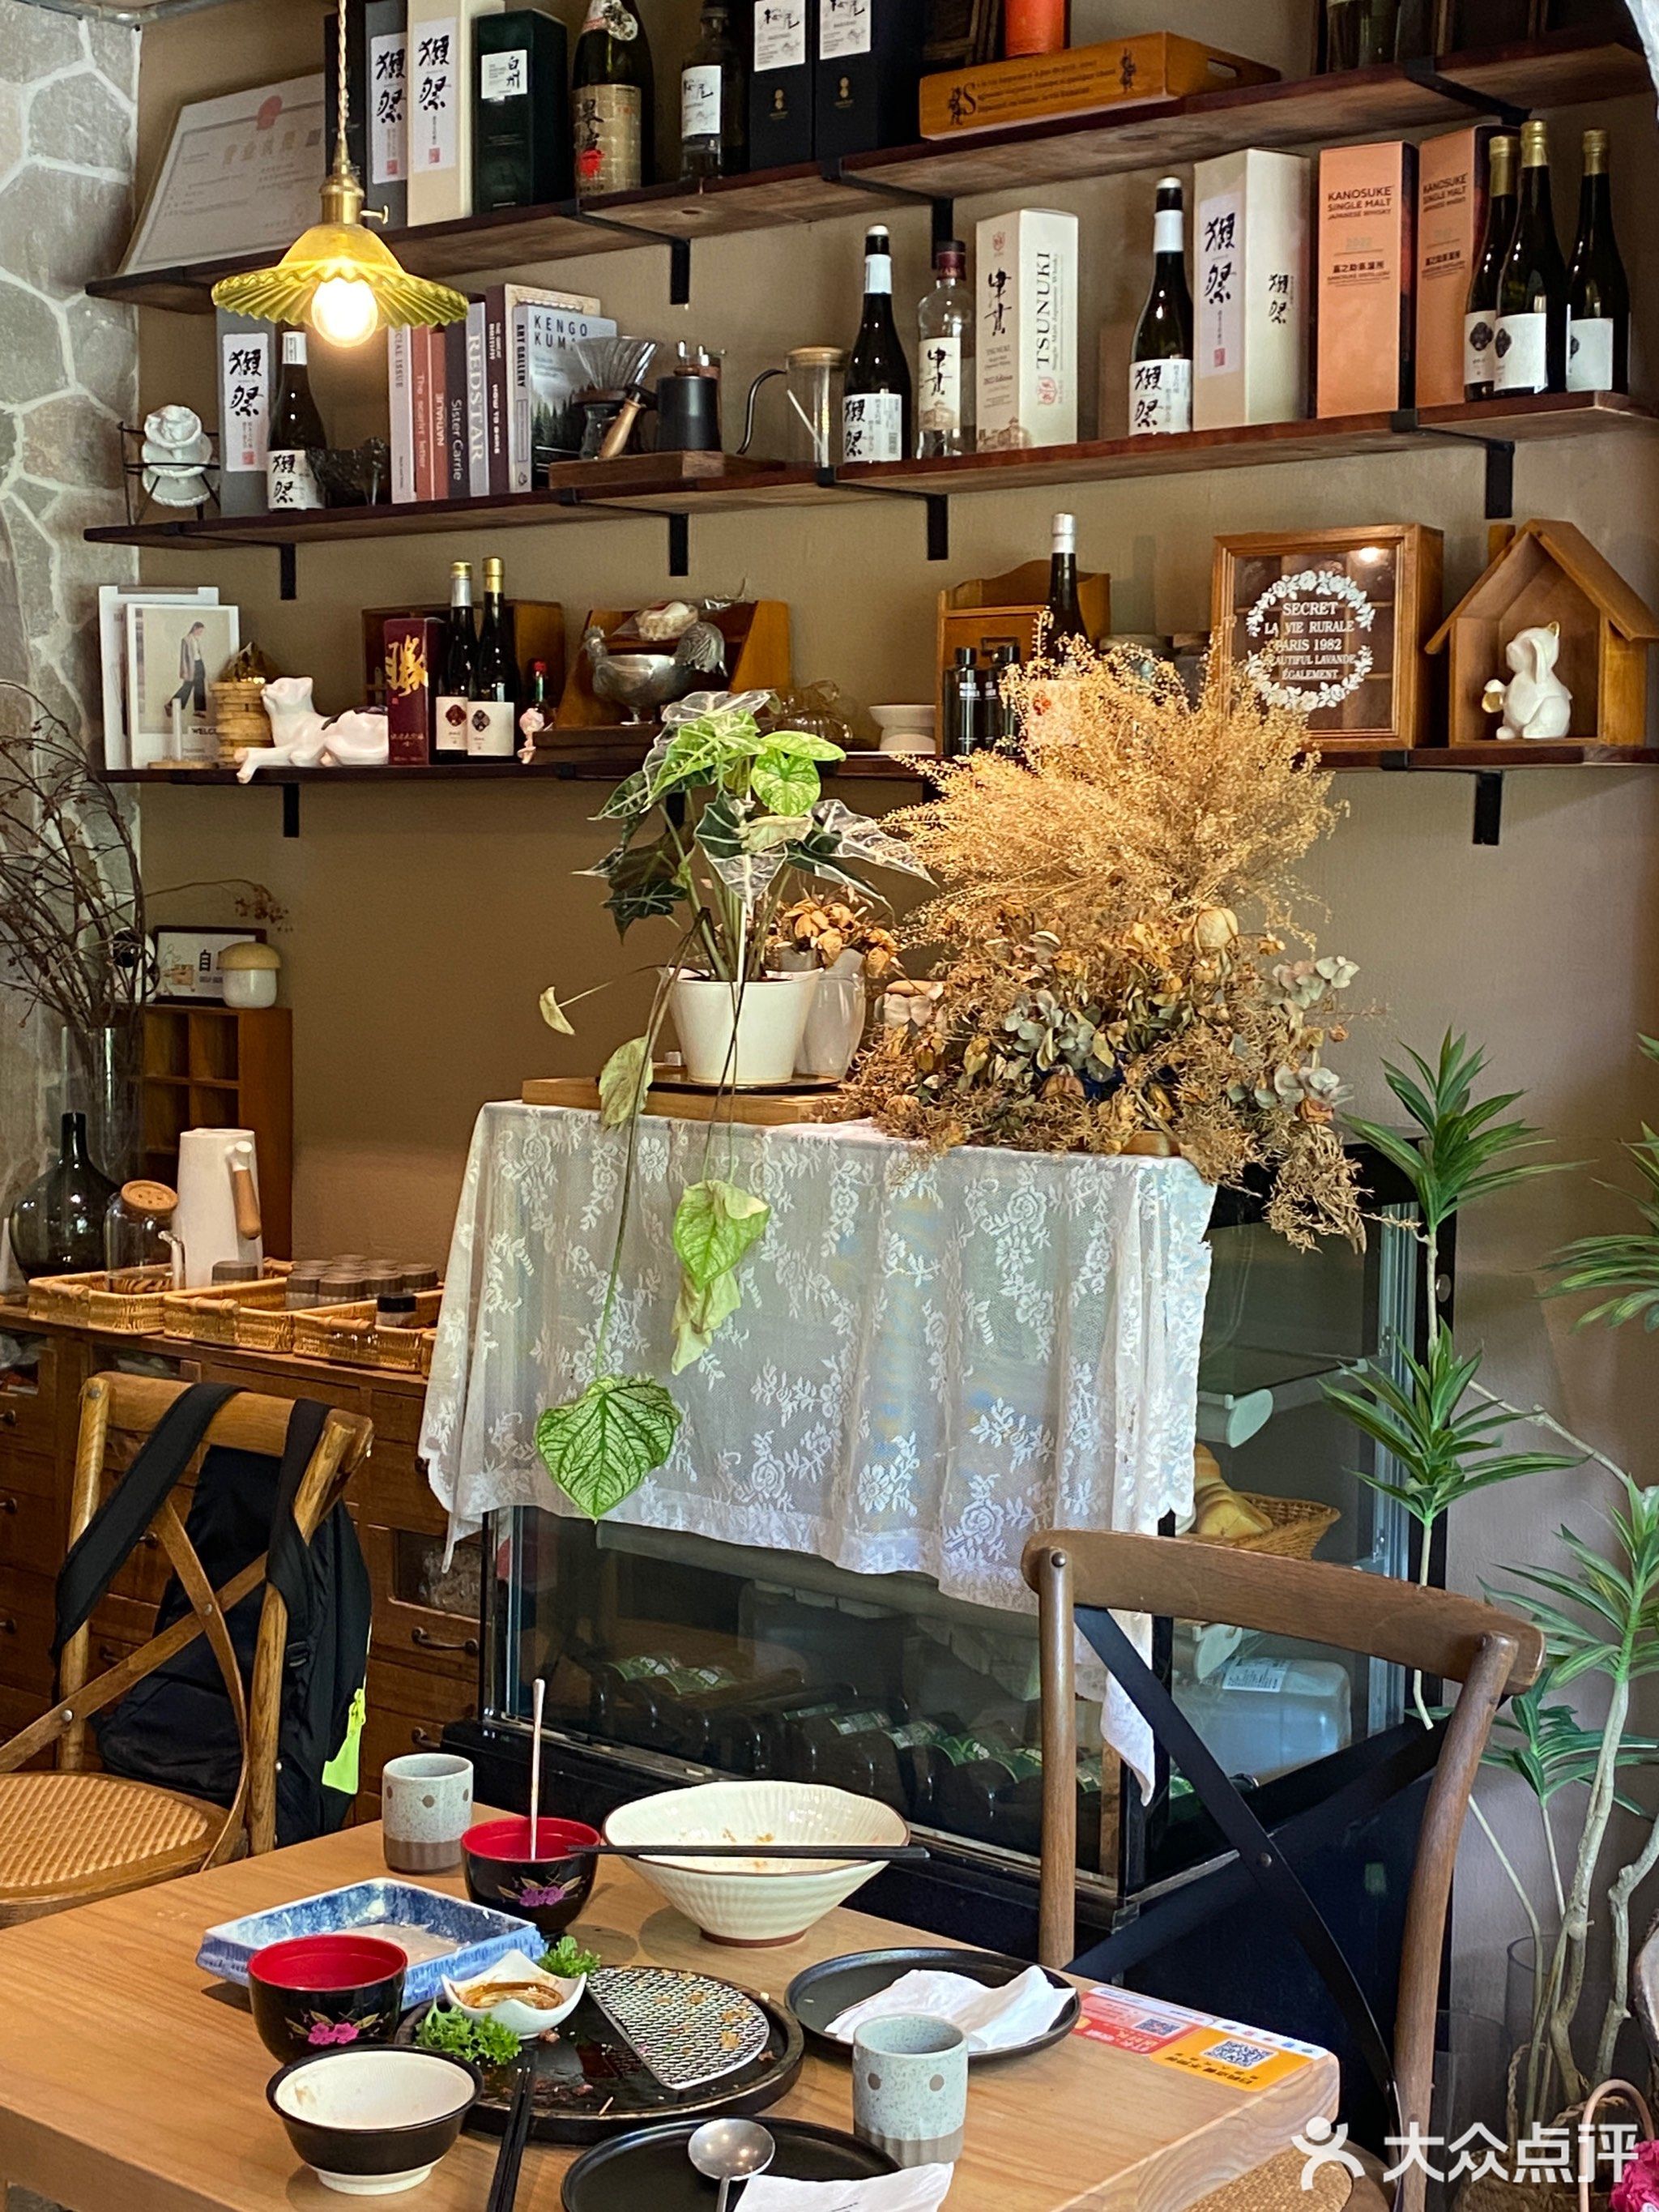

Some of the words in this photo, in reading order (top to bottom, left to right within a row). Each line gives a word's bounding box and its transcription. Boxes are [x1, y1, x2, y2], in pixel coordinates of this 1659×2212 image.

[1328, 186, 1392, 201] KANOSUKE
[1423, 174, 1468, 194] KANOSUKE
[1328, 200, 1362, 211] SINGLE
[1365, 198, 1391, 209] MALT
[1036, 252, 1051, 369] TSUNUKI
[516, 324, 526, 343] ART
[535, 314, 587, 336] KENGO
[395, 361, 404, 388] ISSUE
[516, 347, 527, 388] GALLERY
[416, 374, 425, 395] The
[468, 333, 484, 463] REDSTAR
[450, 399, 463, 437] Sister
[452, 440, 464, 481] Carrie
[1282, 601, 1339, 616] SECRET
[1264, 621, 1279, 636] LA
[1284, 621, 1304, 634] VIE
[1308, 620, 1355, 633] RURALE
[1313, 638, 1342, 651] 1982
[1275, 655, 1314, 665] AUTIFUL
